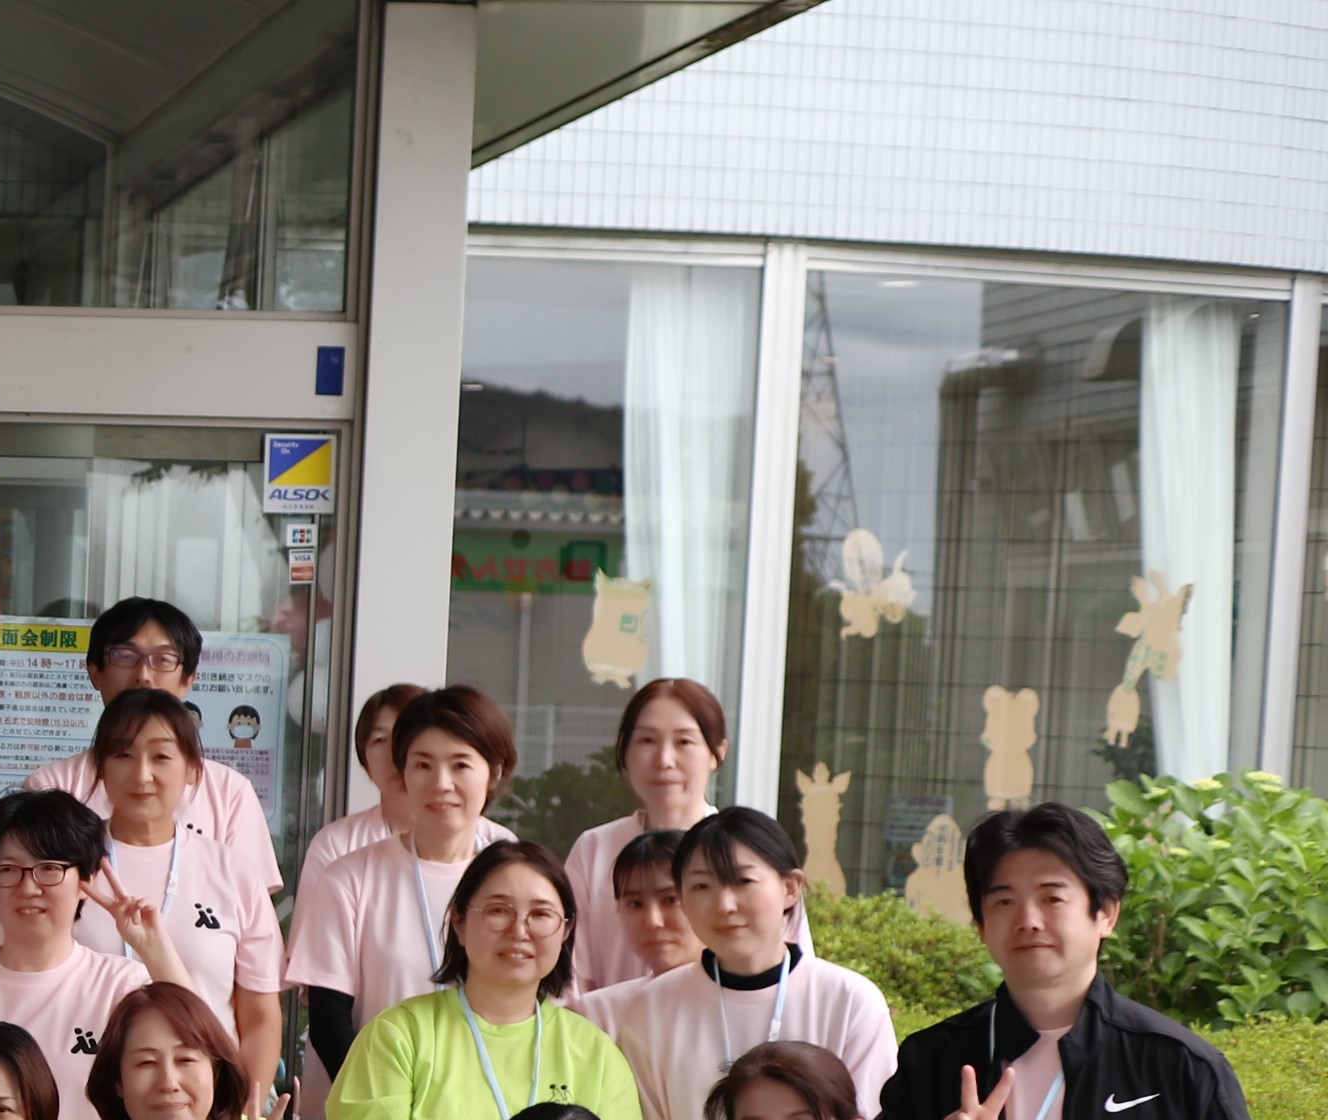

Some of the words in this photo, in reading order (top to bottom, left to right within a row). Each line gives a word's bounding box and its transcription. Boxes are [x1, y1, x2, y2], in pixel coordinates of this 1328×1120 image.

[269, 488, 331, 501] ALSOK
[2, 628, 77, 648] 面会制限
